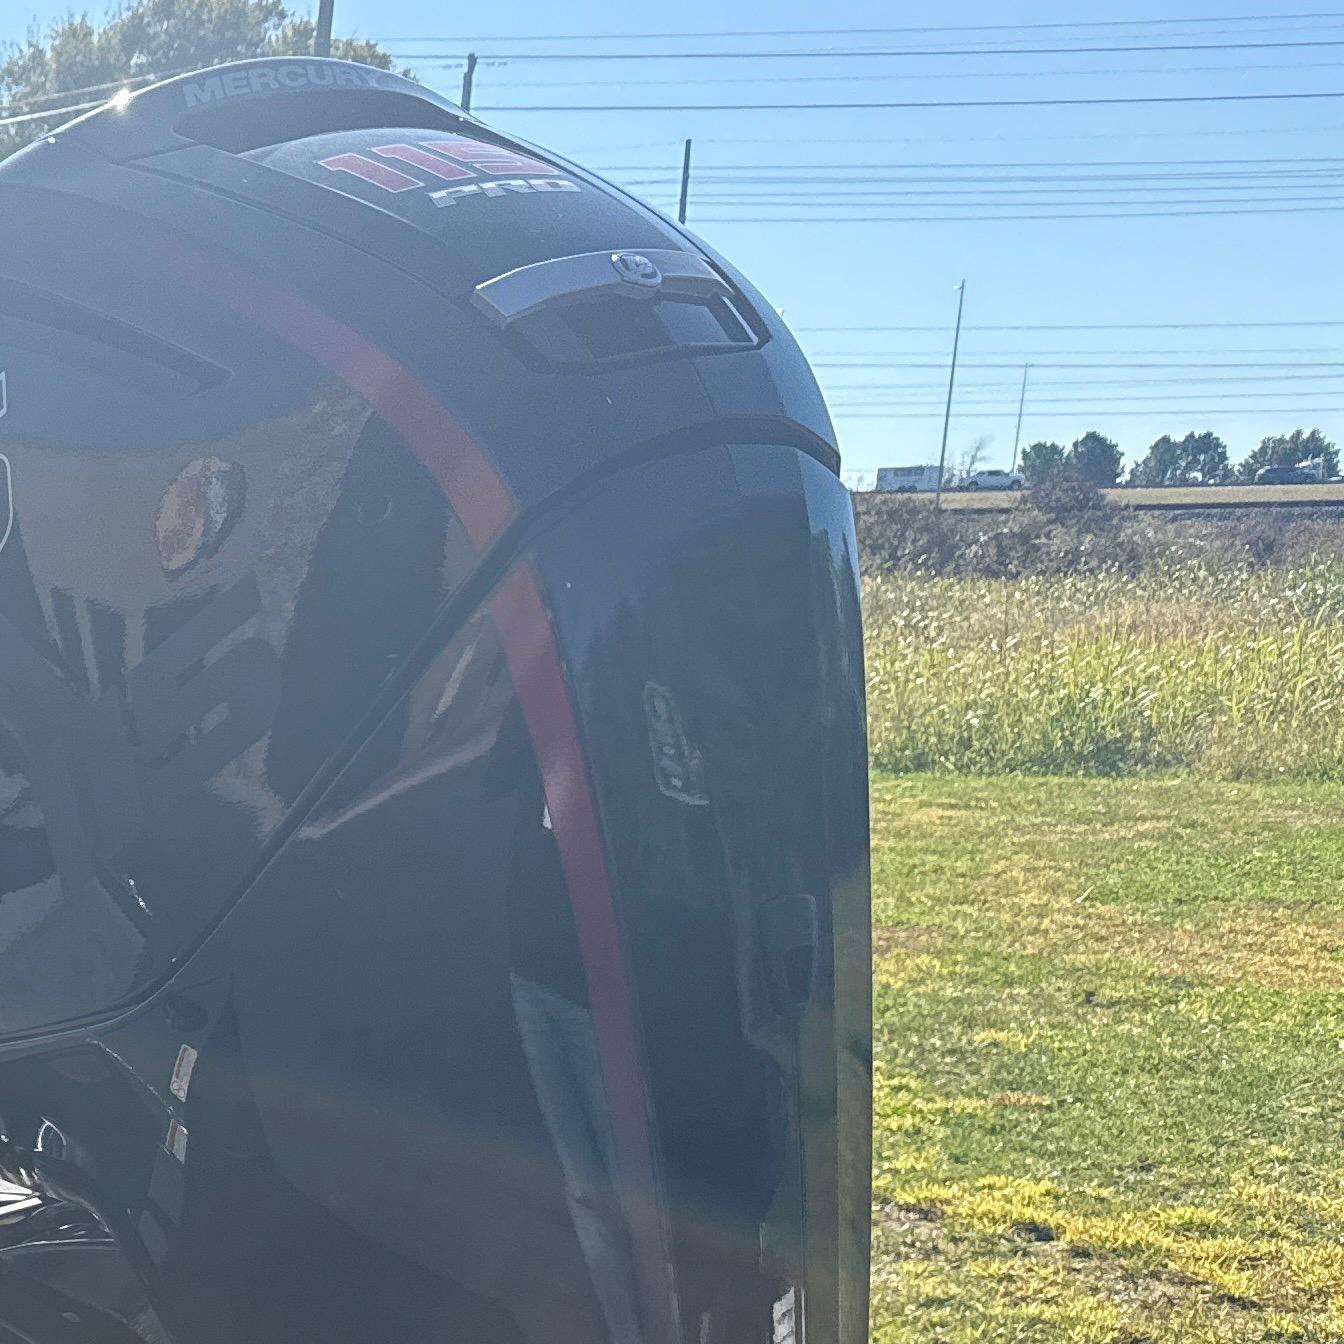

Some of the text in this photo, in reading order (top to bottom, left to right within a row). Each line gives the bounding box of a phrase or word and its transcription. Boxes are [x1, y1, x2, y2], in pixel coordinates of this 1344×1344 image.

[183, 62, 386, 108] MERCURY
[316, 140, 559, 193] 115
[427, 177, 582, 209] PRO
